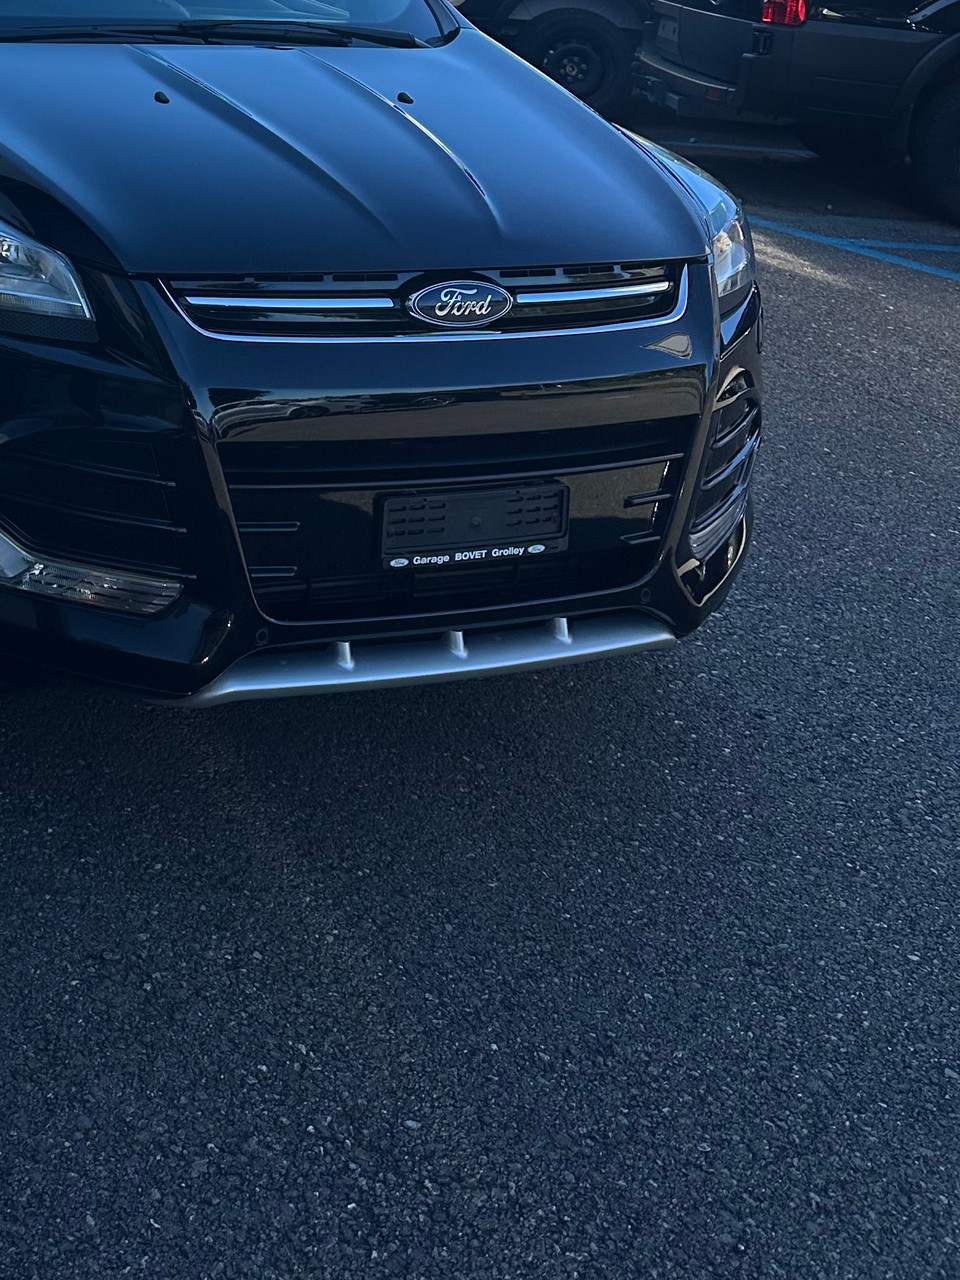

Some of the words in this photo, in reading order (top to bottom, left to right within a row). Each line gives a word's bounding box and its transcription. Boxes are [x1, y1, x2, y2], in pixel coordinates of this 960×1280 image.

[435, 288, 492, 316] Ford
[412, 554, 450, 565] Garage
[454, 549, 488, 562] BOVET
[491, 546, 525, 558] Grolley
